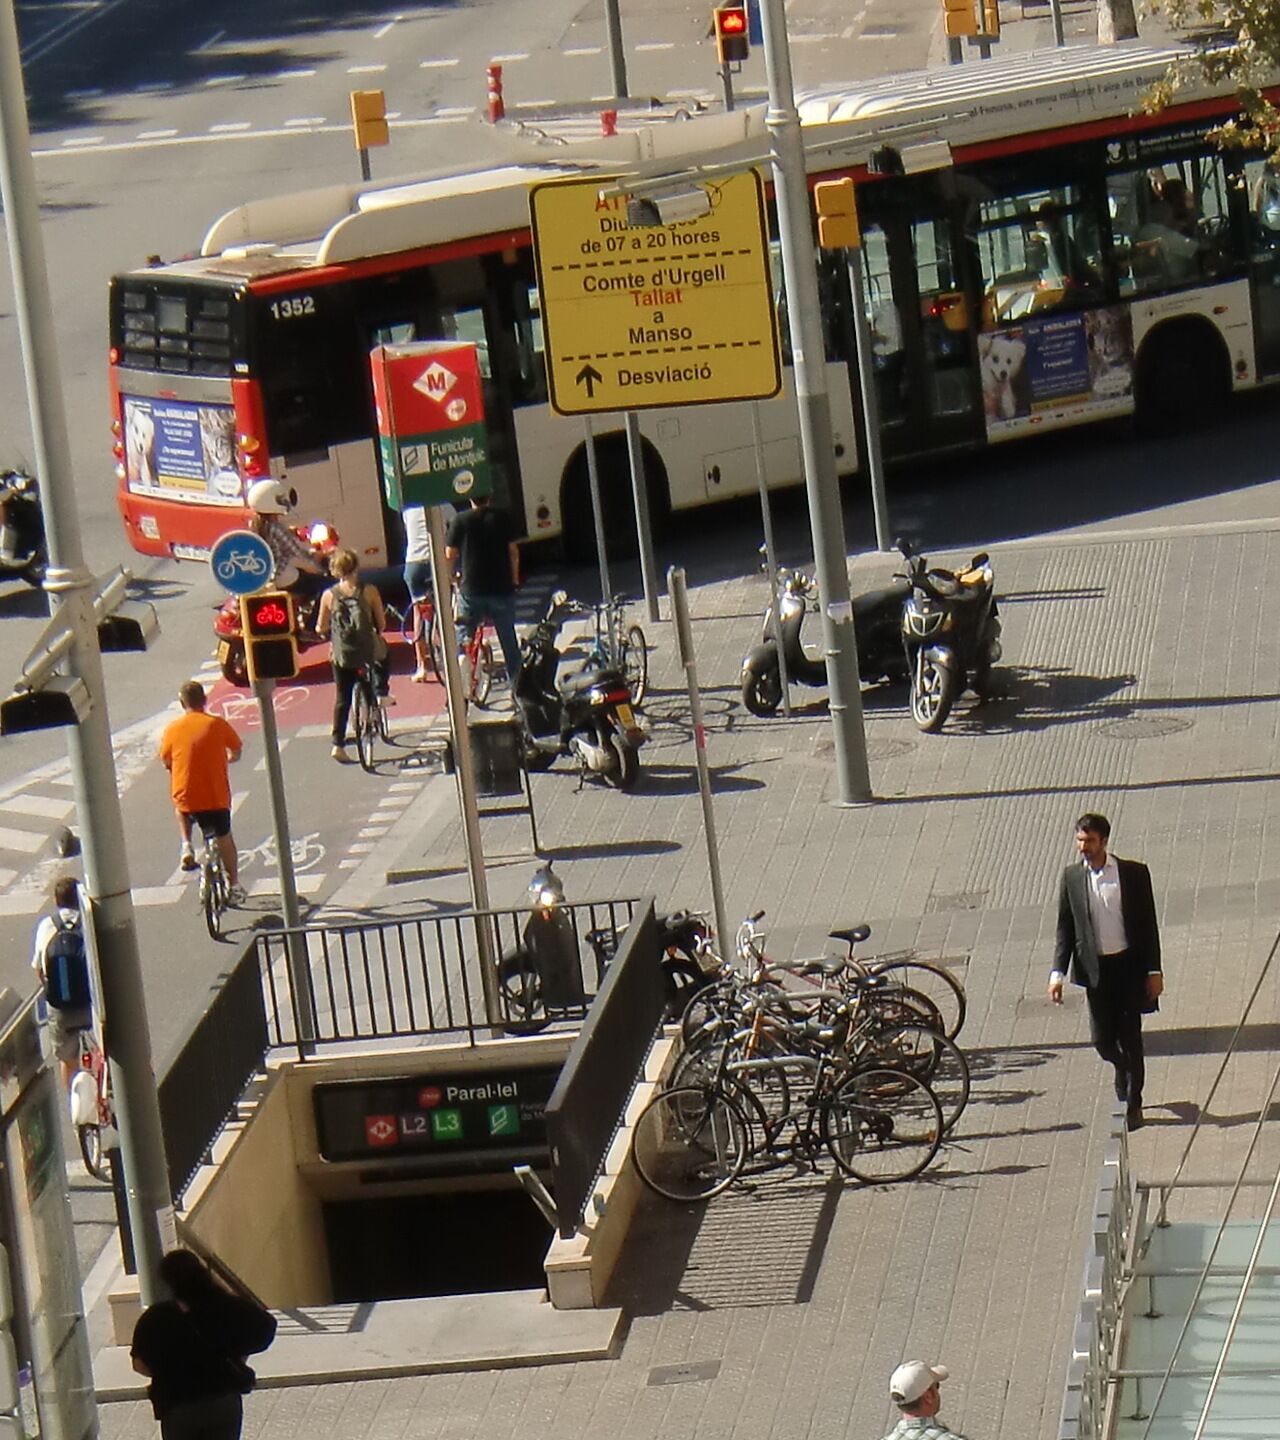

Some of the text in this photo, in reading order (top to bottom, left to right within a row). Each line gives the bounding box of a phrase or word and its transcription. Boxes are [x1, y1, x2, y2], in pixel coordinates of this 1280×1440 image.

[580, 230, 720, 254] de 07 a 20 hores
[583, 264, 726, 292] Comte d'Urgell
[629, 288, 683, 307] Tallat
[270, 296, 315, 319] 1352
[653, 311, 664, 324] a
[628, 326, 692, 344] Manso
[427, 372, 446, 392] M
[617, 362, 712, 387] Desviació
[431, 437, 474, 456] Funicular
[432, 457, 446, 472] de
[446, 1082, 518, 1101] Paral·lel
[402, 1116, 427, 1134] L2
[435, 1113, 459, 1131] L3
